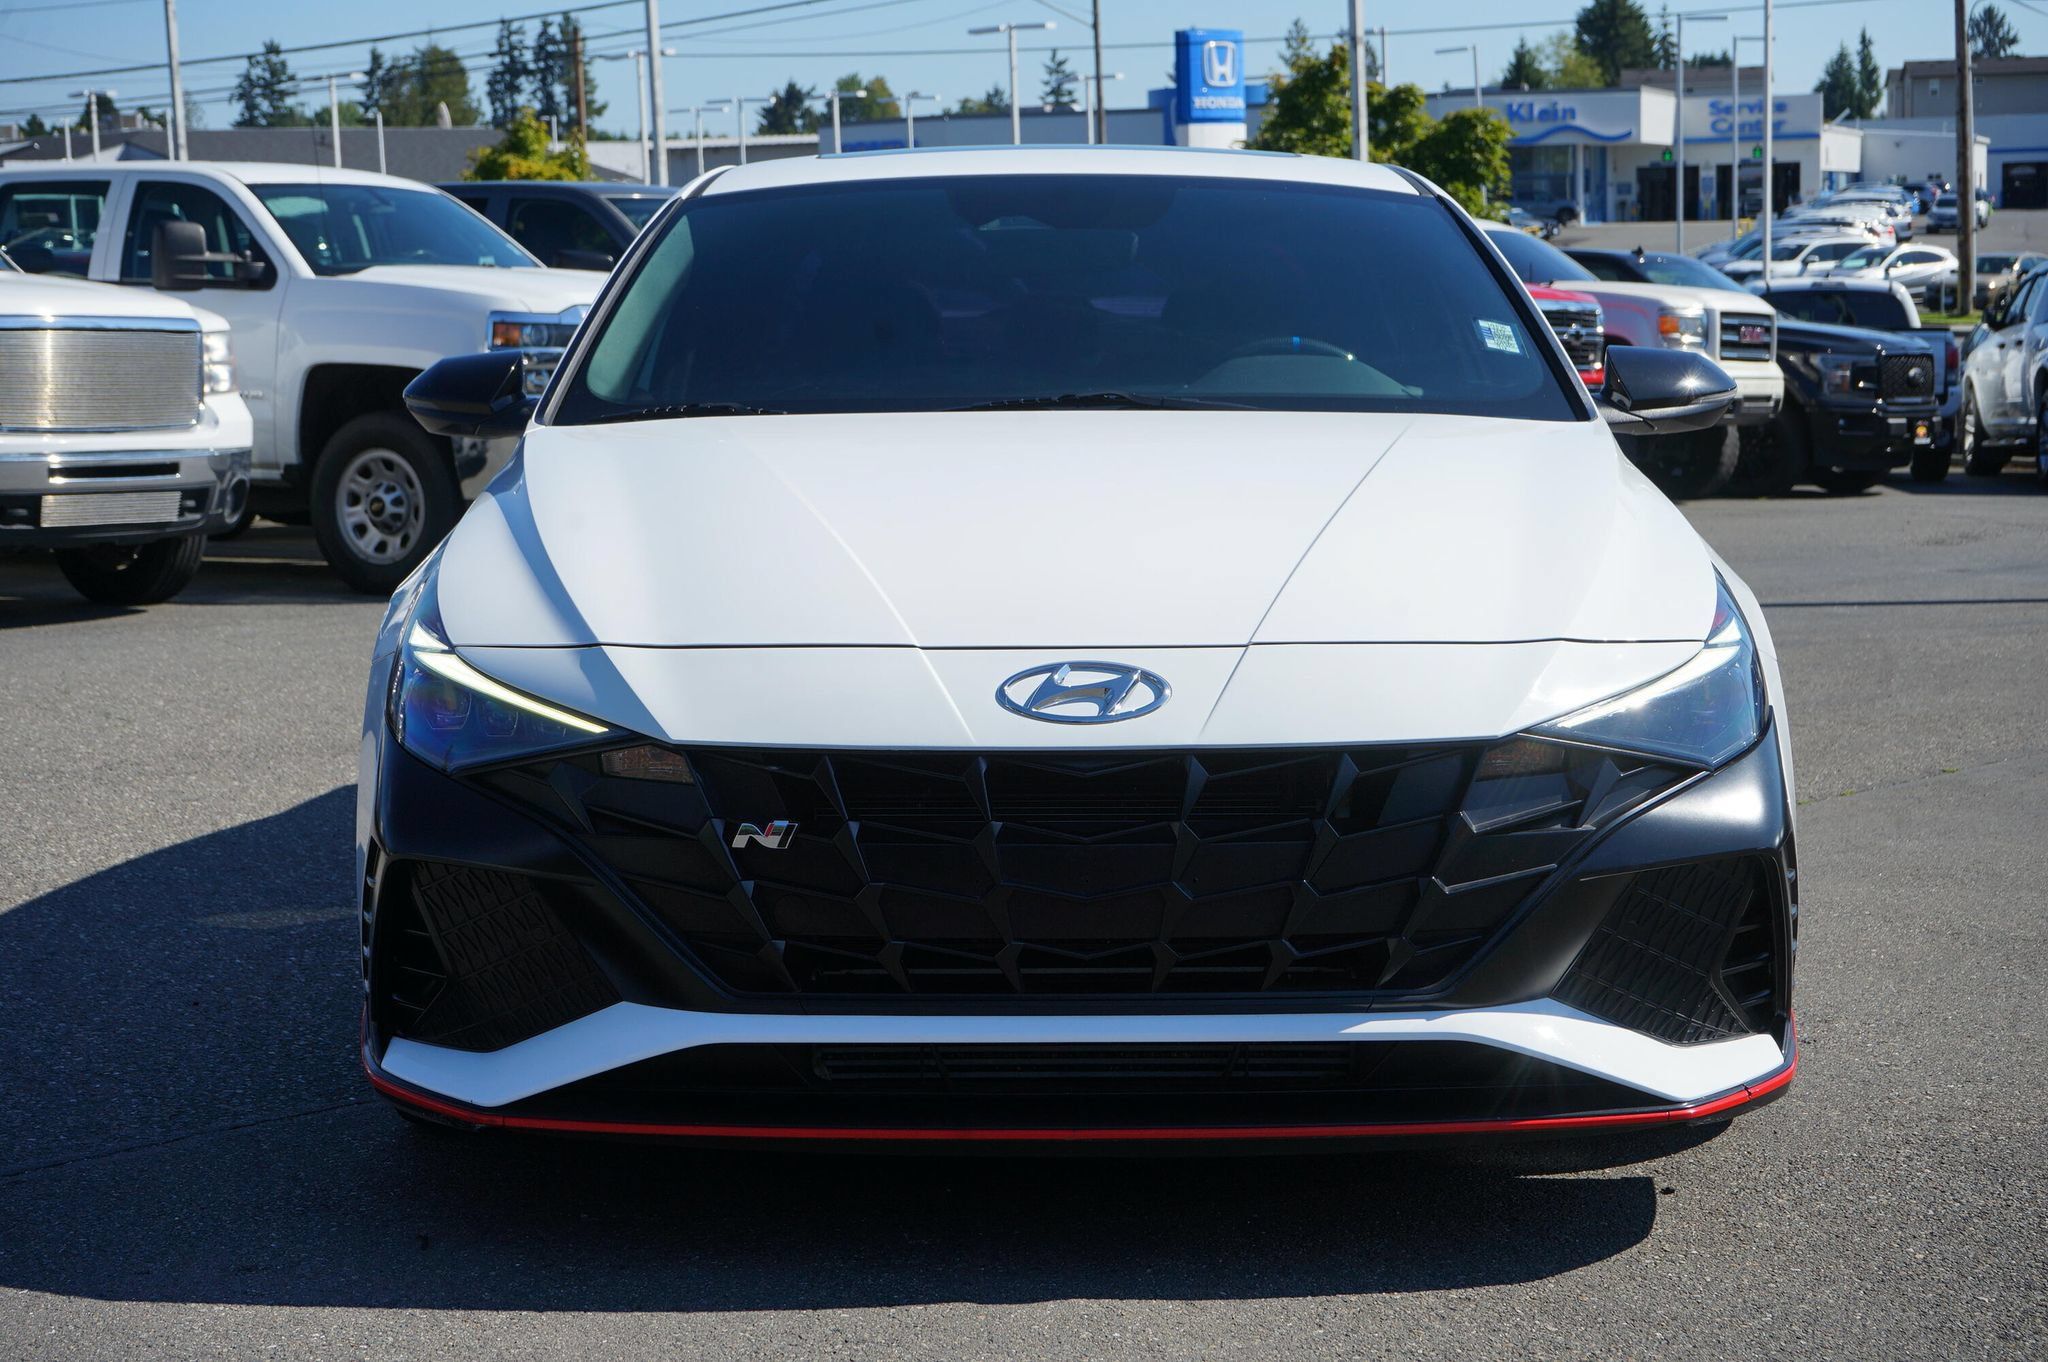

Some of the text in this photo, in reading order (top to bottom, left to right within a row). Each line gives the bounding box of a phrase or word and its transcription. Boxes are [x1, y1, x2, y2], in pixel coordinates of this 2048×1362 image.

[1193, 96, 1246, 109] HONDA
[1708, 99, 1787, 116] Servie
[1507, 101, 1576, 122] Klein
[1711, 117, 1787, 134] Centr
